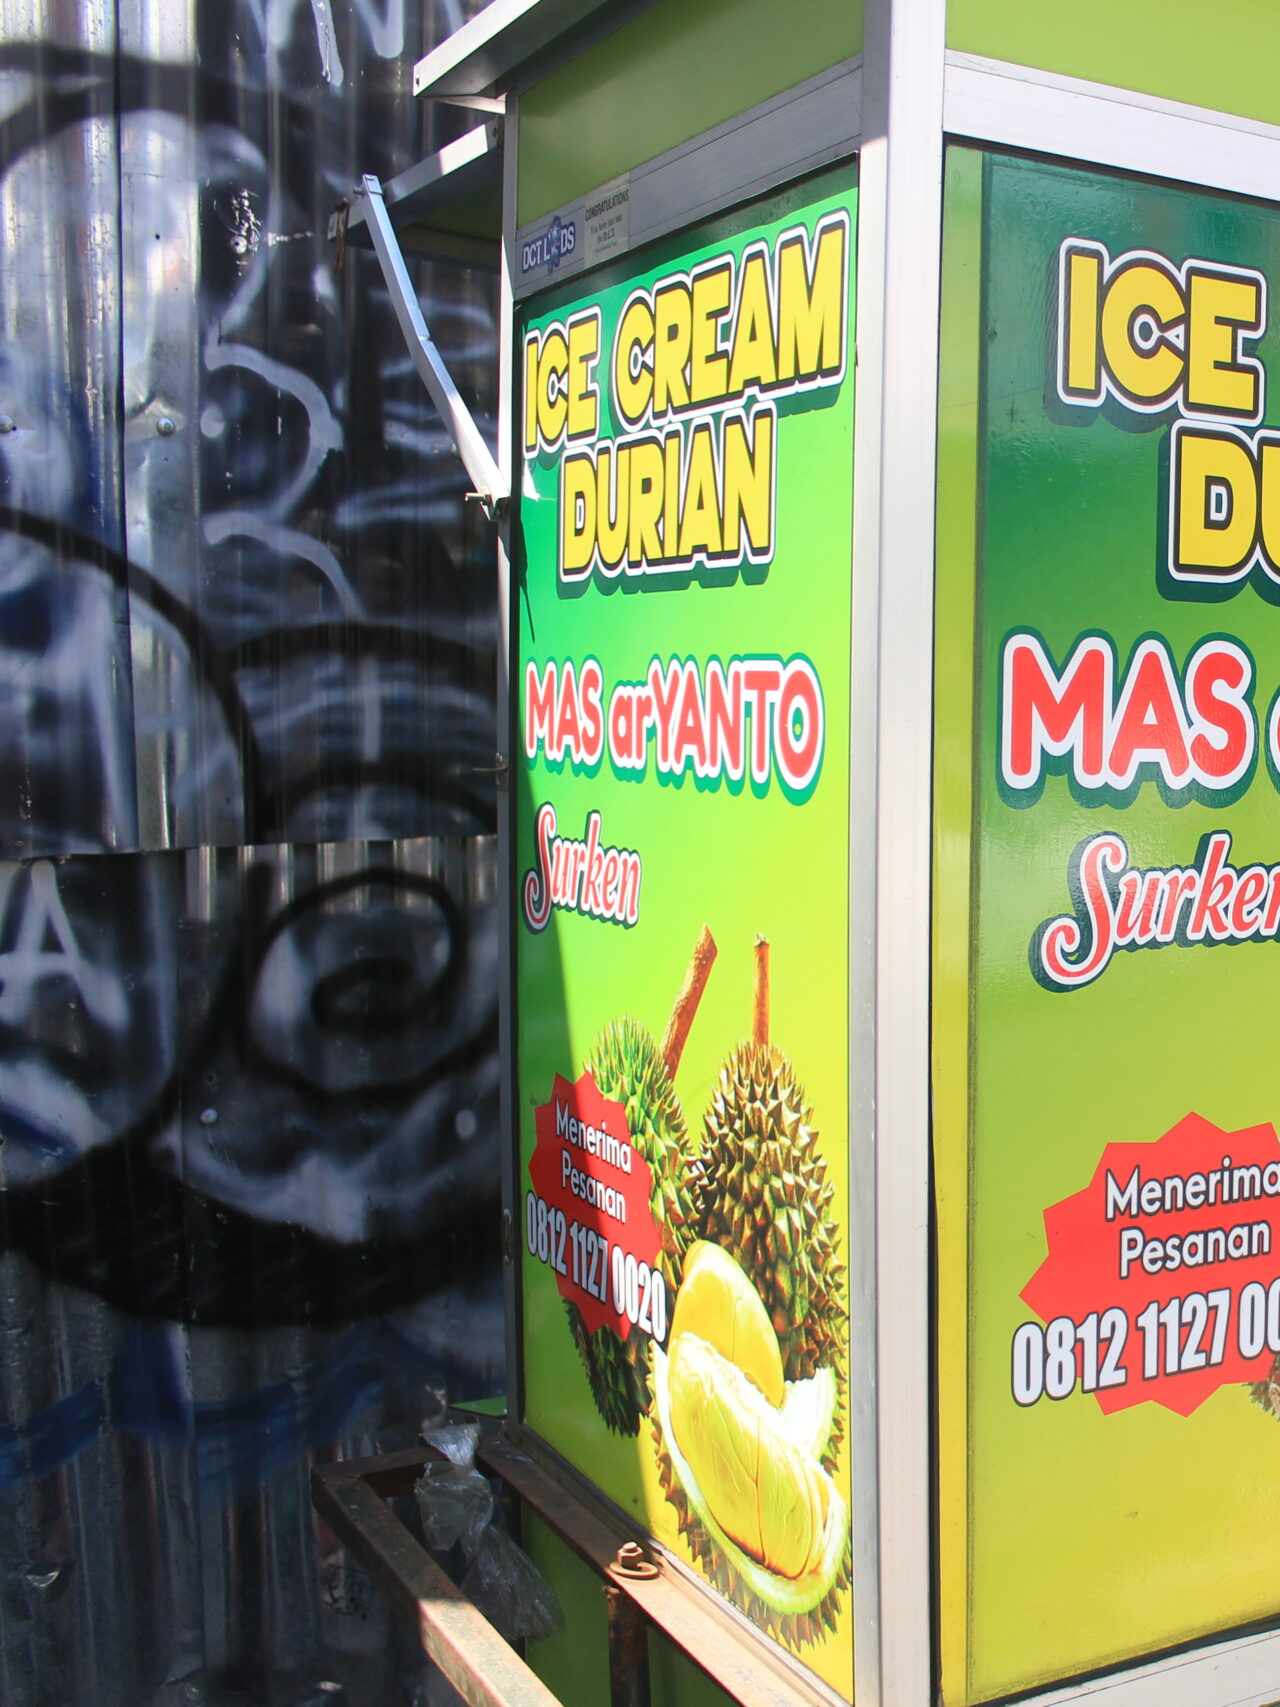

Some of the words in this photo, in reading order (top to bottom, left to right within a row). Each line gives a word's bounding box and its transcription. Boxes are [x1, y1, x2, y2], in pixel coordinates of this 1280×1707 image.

[523, 240, 542, 271] DCT
[524, 305, 601, 458] ICE
[614, 209, 850, 432] CREAM
[1057, 237, 1266, 427] ICE
[560, 401, 776, 582] DURIAN
[526, 660, 603, 766] MAS
[610, 658, 823, 790] arYANTO
[1000, 634, 1252, 791] MAS
[525, 803, 641, 931] Surken
[555, 1098, 631, 1175] Menerima
[561, 1149, 626, 1223] Pesanan
[526, 1190, 567, 1277] 0812
[569, 1220, 608, 1304] 1127
[611, 1244, 667, 1343] 0020
[1119, 1220, 1271, 1279] Pesanan
[1011, 1306, 1128, 1408] 0812
[1136, 1287, 1232, 1380] 1127
